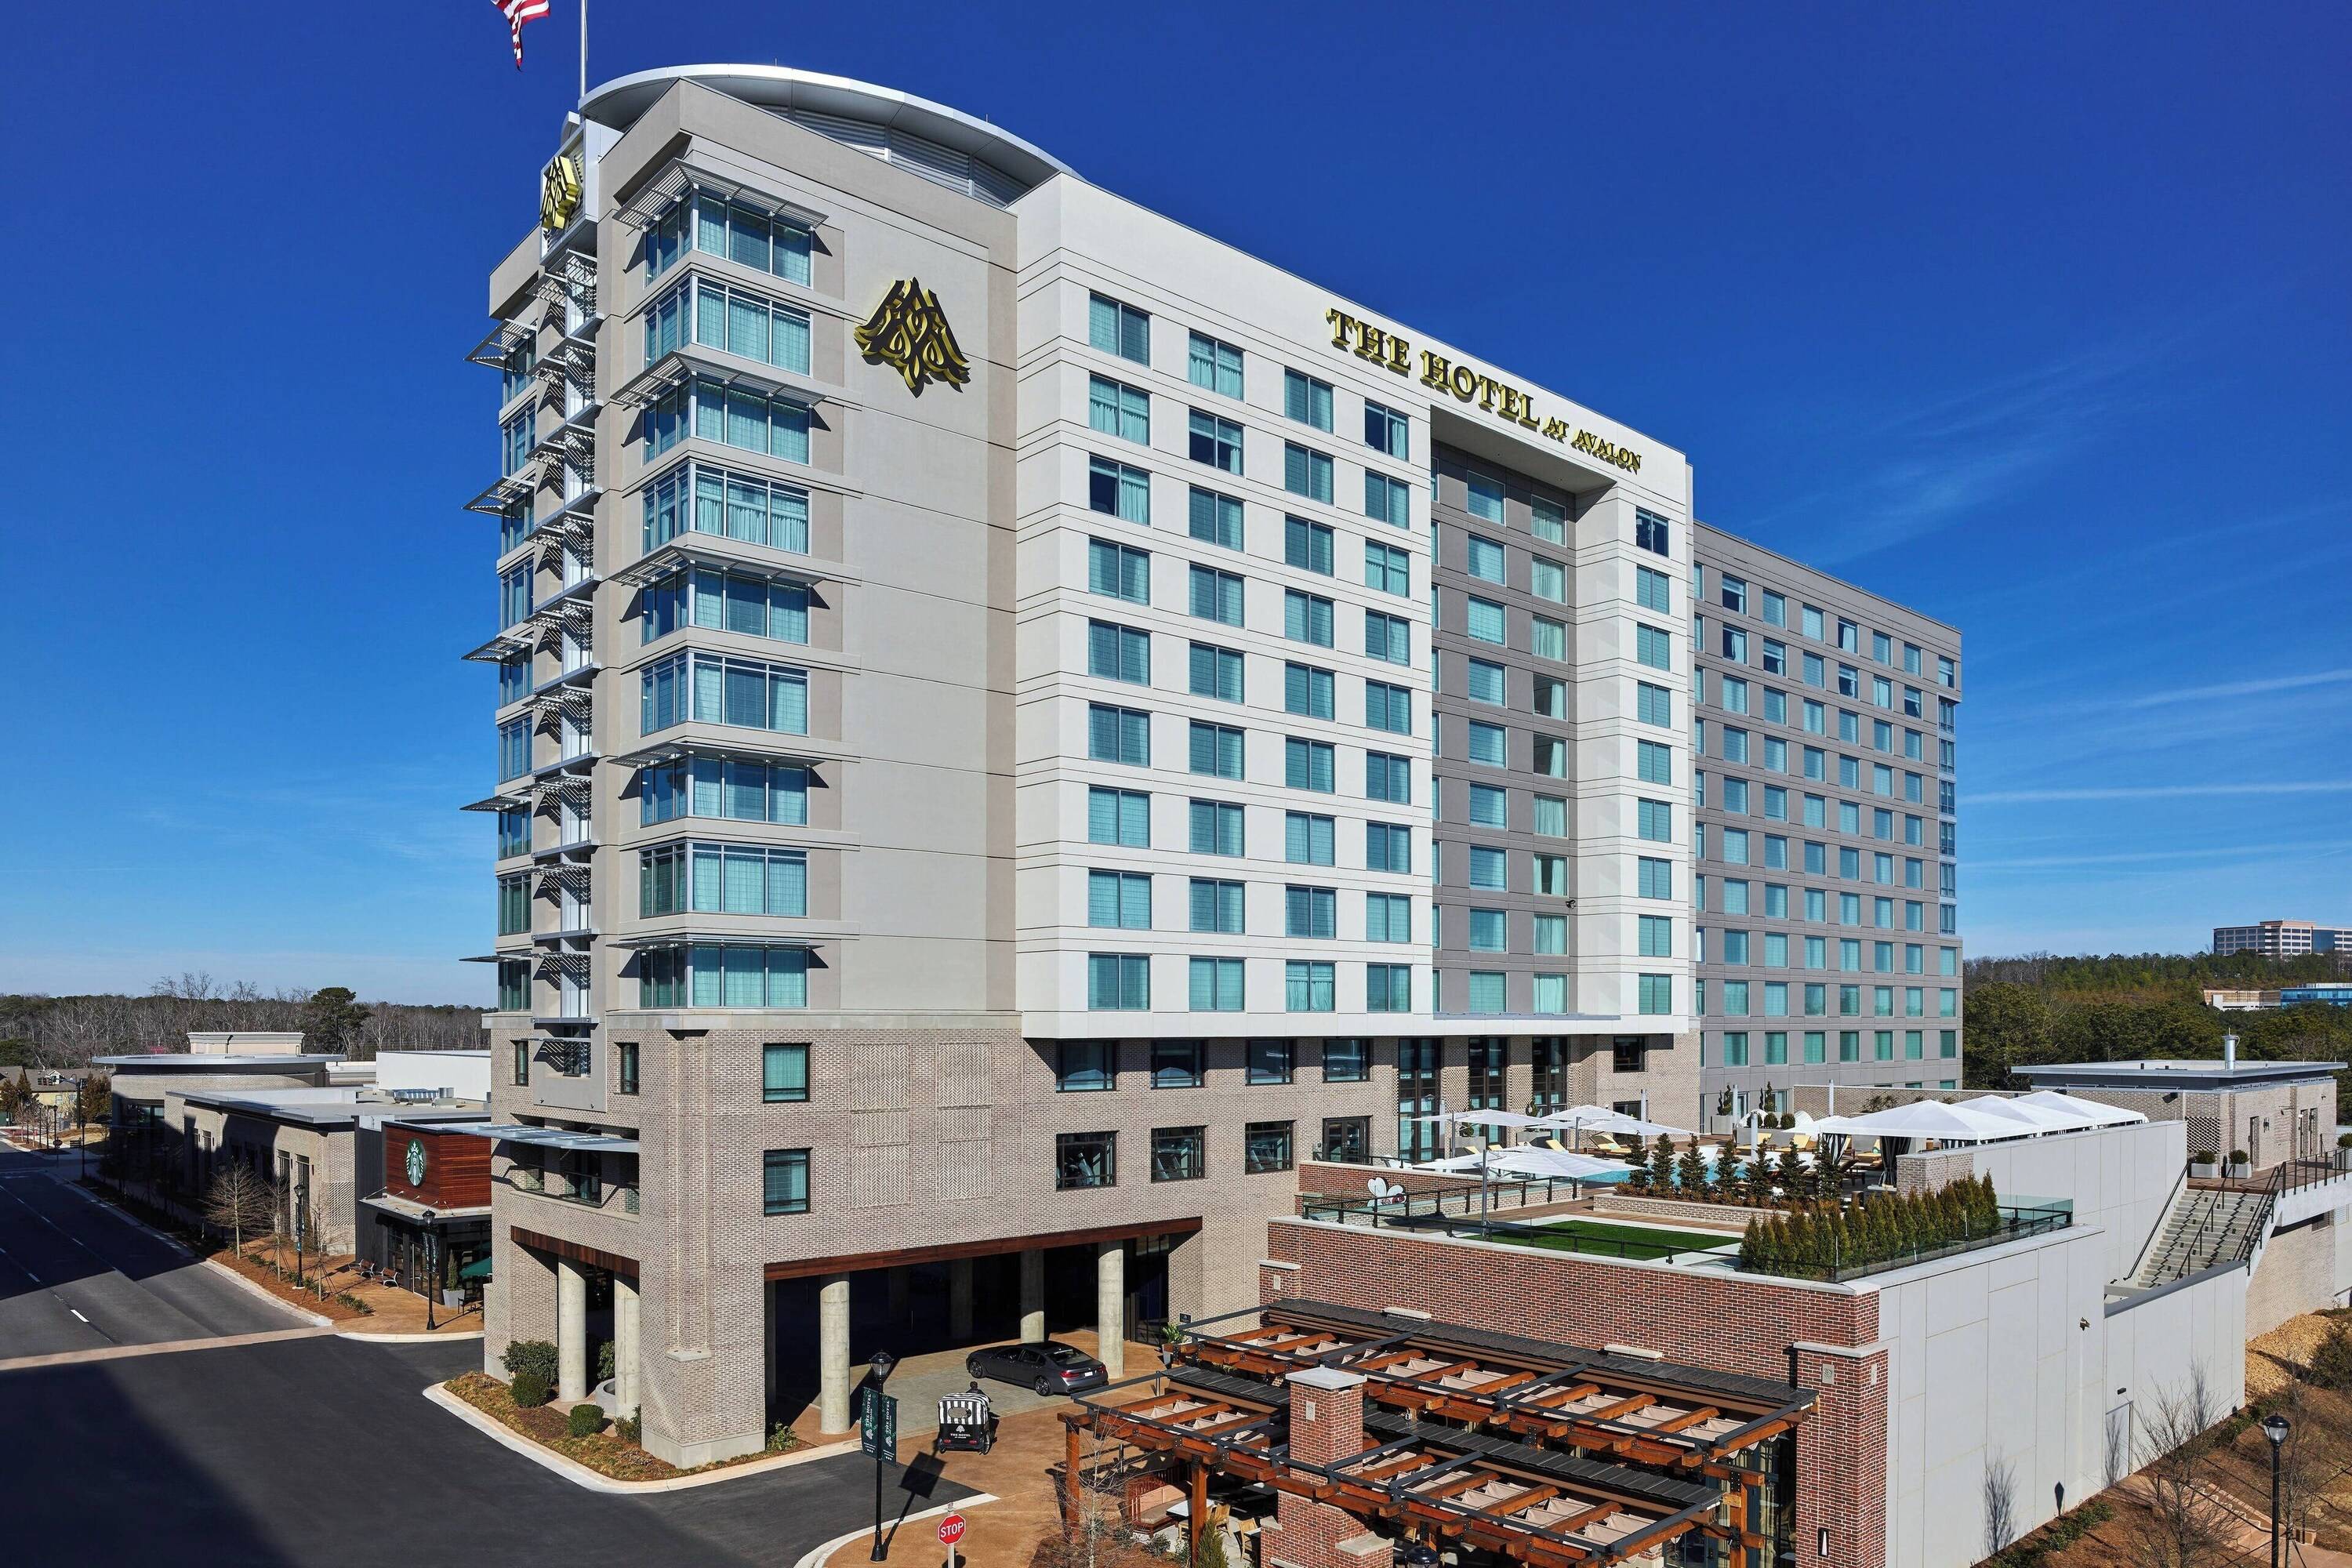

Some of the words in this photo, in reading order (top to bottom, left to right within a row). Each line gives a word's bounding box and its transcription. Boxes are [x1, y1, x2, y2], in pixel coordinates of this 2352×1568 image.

[1326, 308, 1411, 372] THE
[1420, 349, 1541, 425] HOTEL
[1542, 416, 1570, 440] AT
[1572, 428, 1642, 473] AVALON
[940, 1522, 964, 1538] STOP
